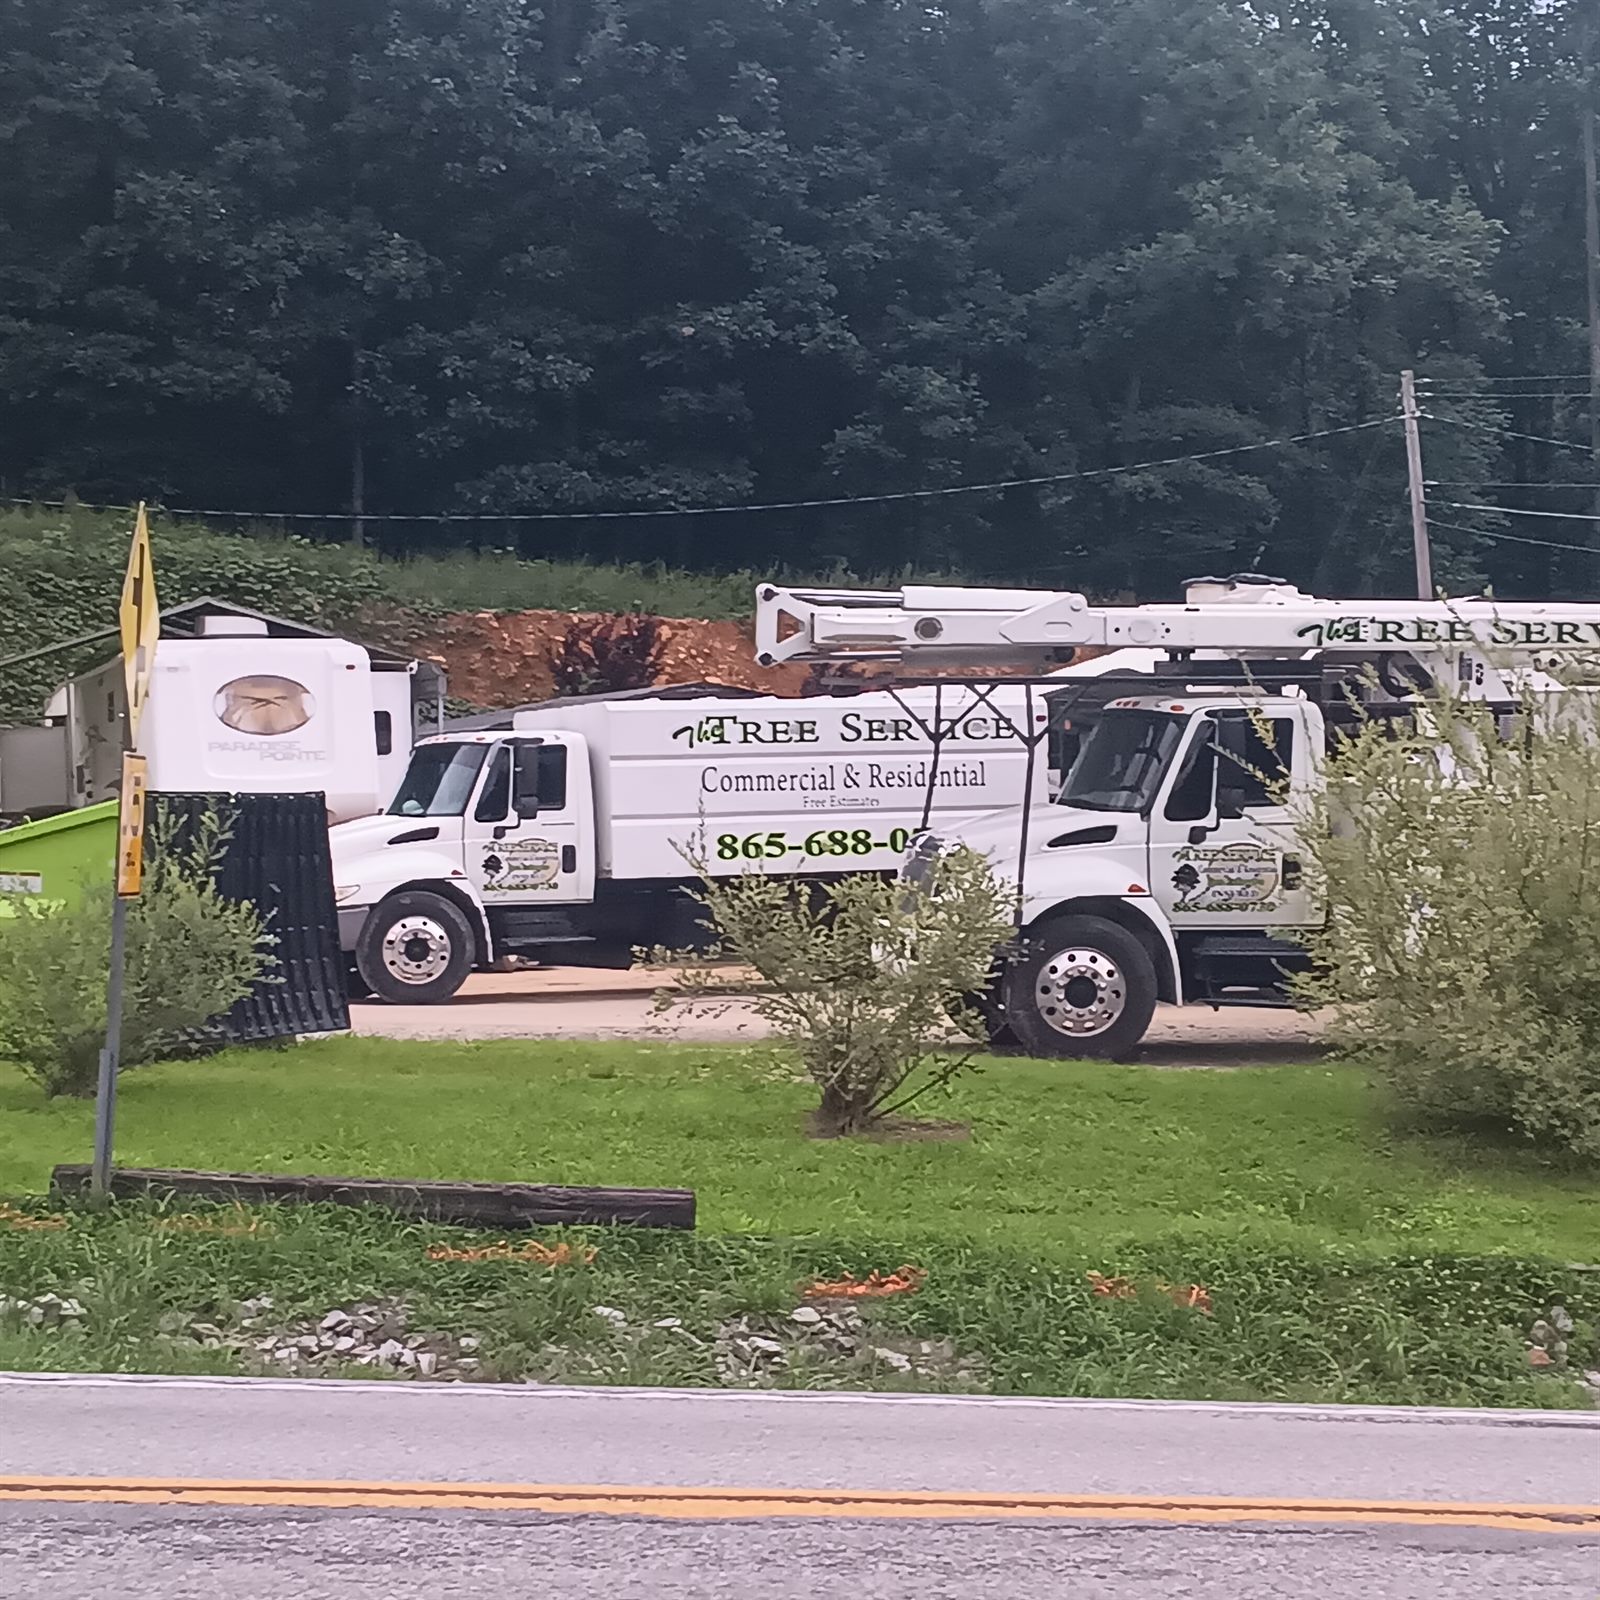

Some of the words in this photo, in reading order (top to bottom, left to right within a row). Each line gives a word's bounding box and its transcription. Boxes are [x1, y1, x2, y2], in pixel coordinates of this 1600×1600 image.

[672, 720, 723, 748] The
[705, 716, 819, 744] TREE
[208, 741, 301, 752] PARADISE
[260, 751, 326, 761] POINTE
[701, 766, 836, 793] Commercial
[843, 763, 861, 789] &
[869, 761, 986, 788] Residntial
